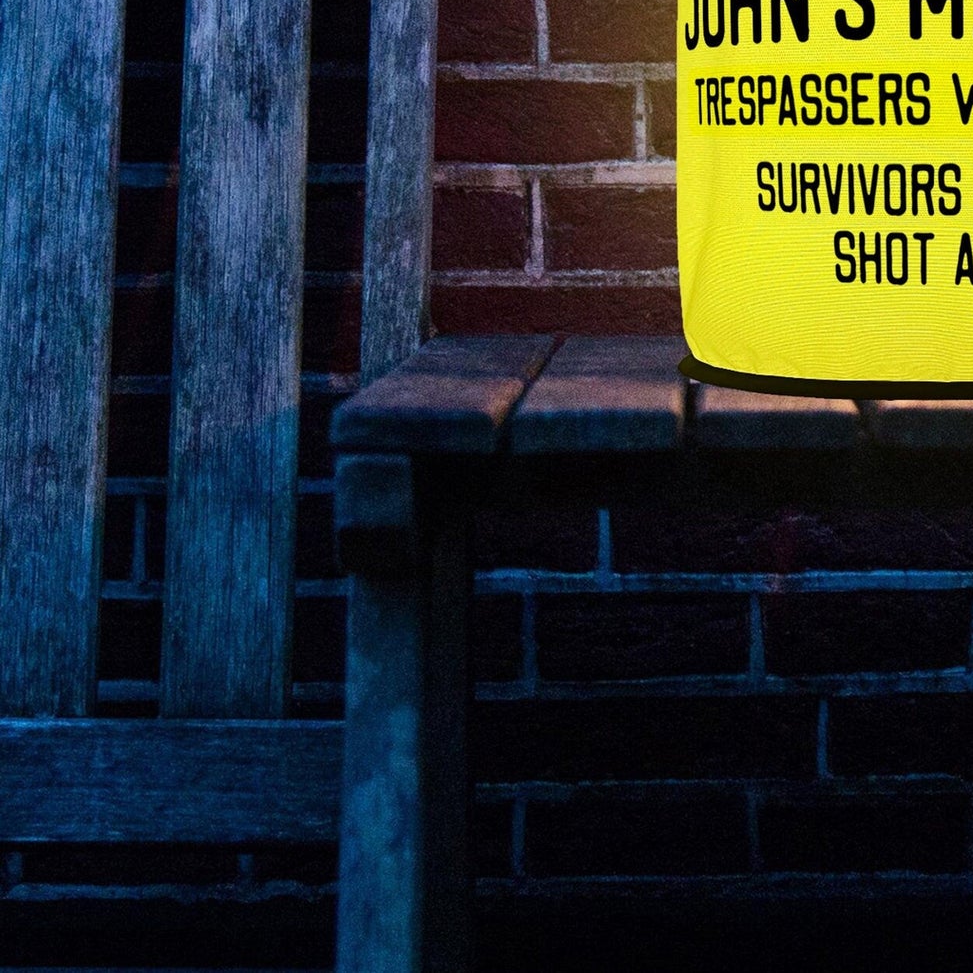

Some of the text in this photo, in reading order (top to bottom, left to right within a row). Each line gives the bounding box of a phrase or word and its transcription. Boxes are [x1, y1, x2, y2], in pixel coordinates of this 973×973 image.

[694, 72, 931, 127] TRESPASSERS
[756, 161, 962, 216] SURVIVORS
[833, 230, 935, 286] SHOT
